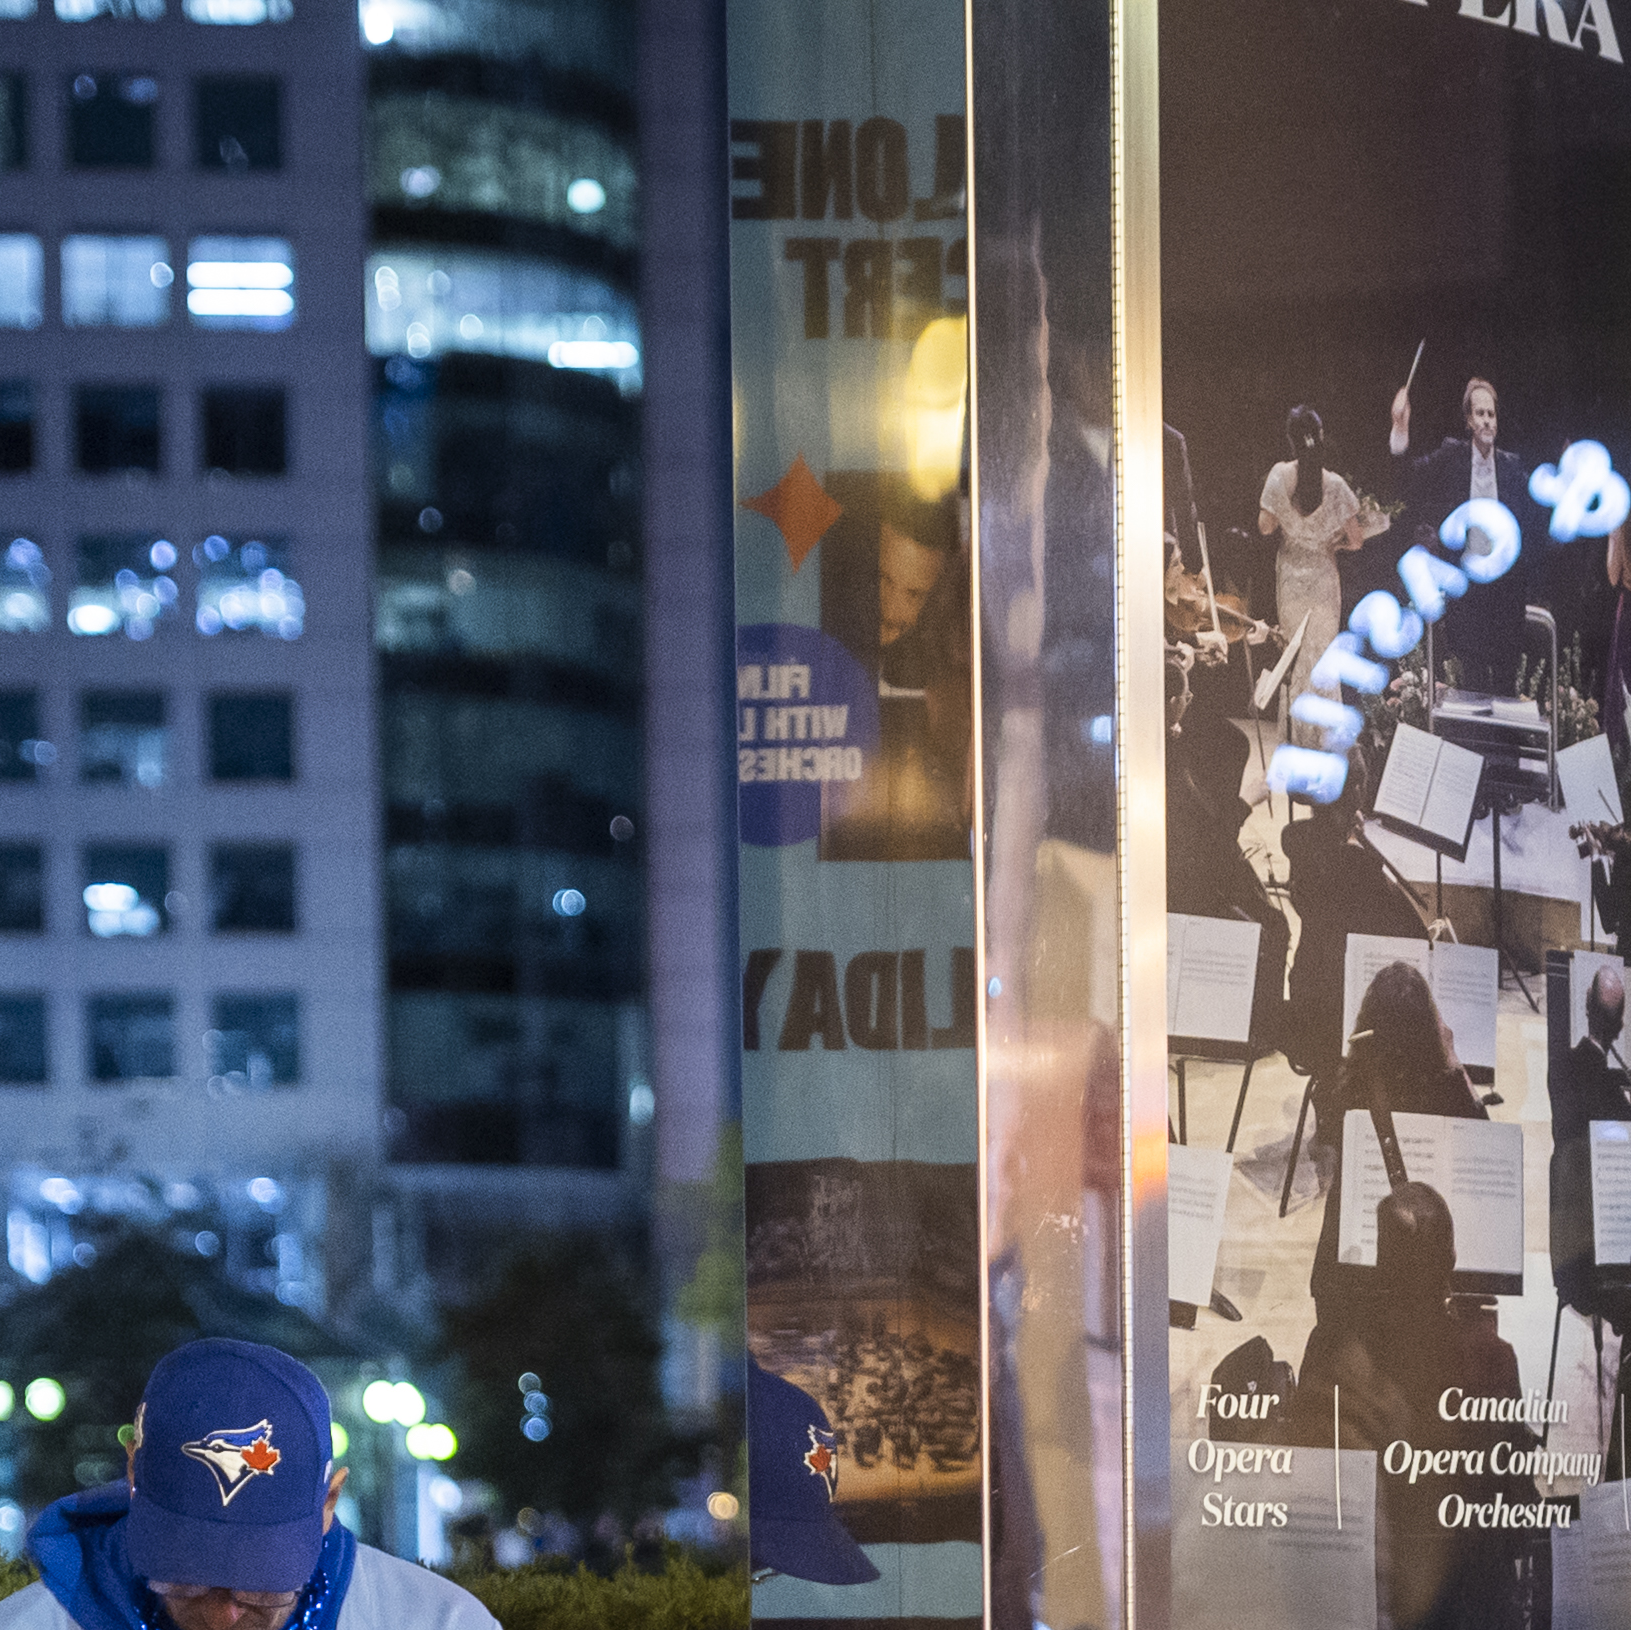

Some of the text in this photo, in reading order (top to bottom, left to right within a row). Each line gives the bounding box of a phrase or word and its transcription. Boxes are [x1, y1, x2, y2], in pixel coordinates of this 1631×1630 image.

[1196, 1384, 1280, 1420] Four
[1438, 1387, 1570, 1424] Canadian
[1187, 1438, 1293, 1481] Opera
[1383, 1439, 1602, 1485] Opera Company
[1202, 1492, 1289, 1528] Stars
[1438, 1493, 1572, 1529] Orchestra
